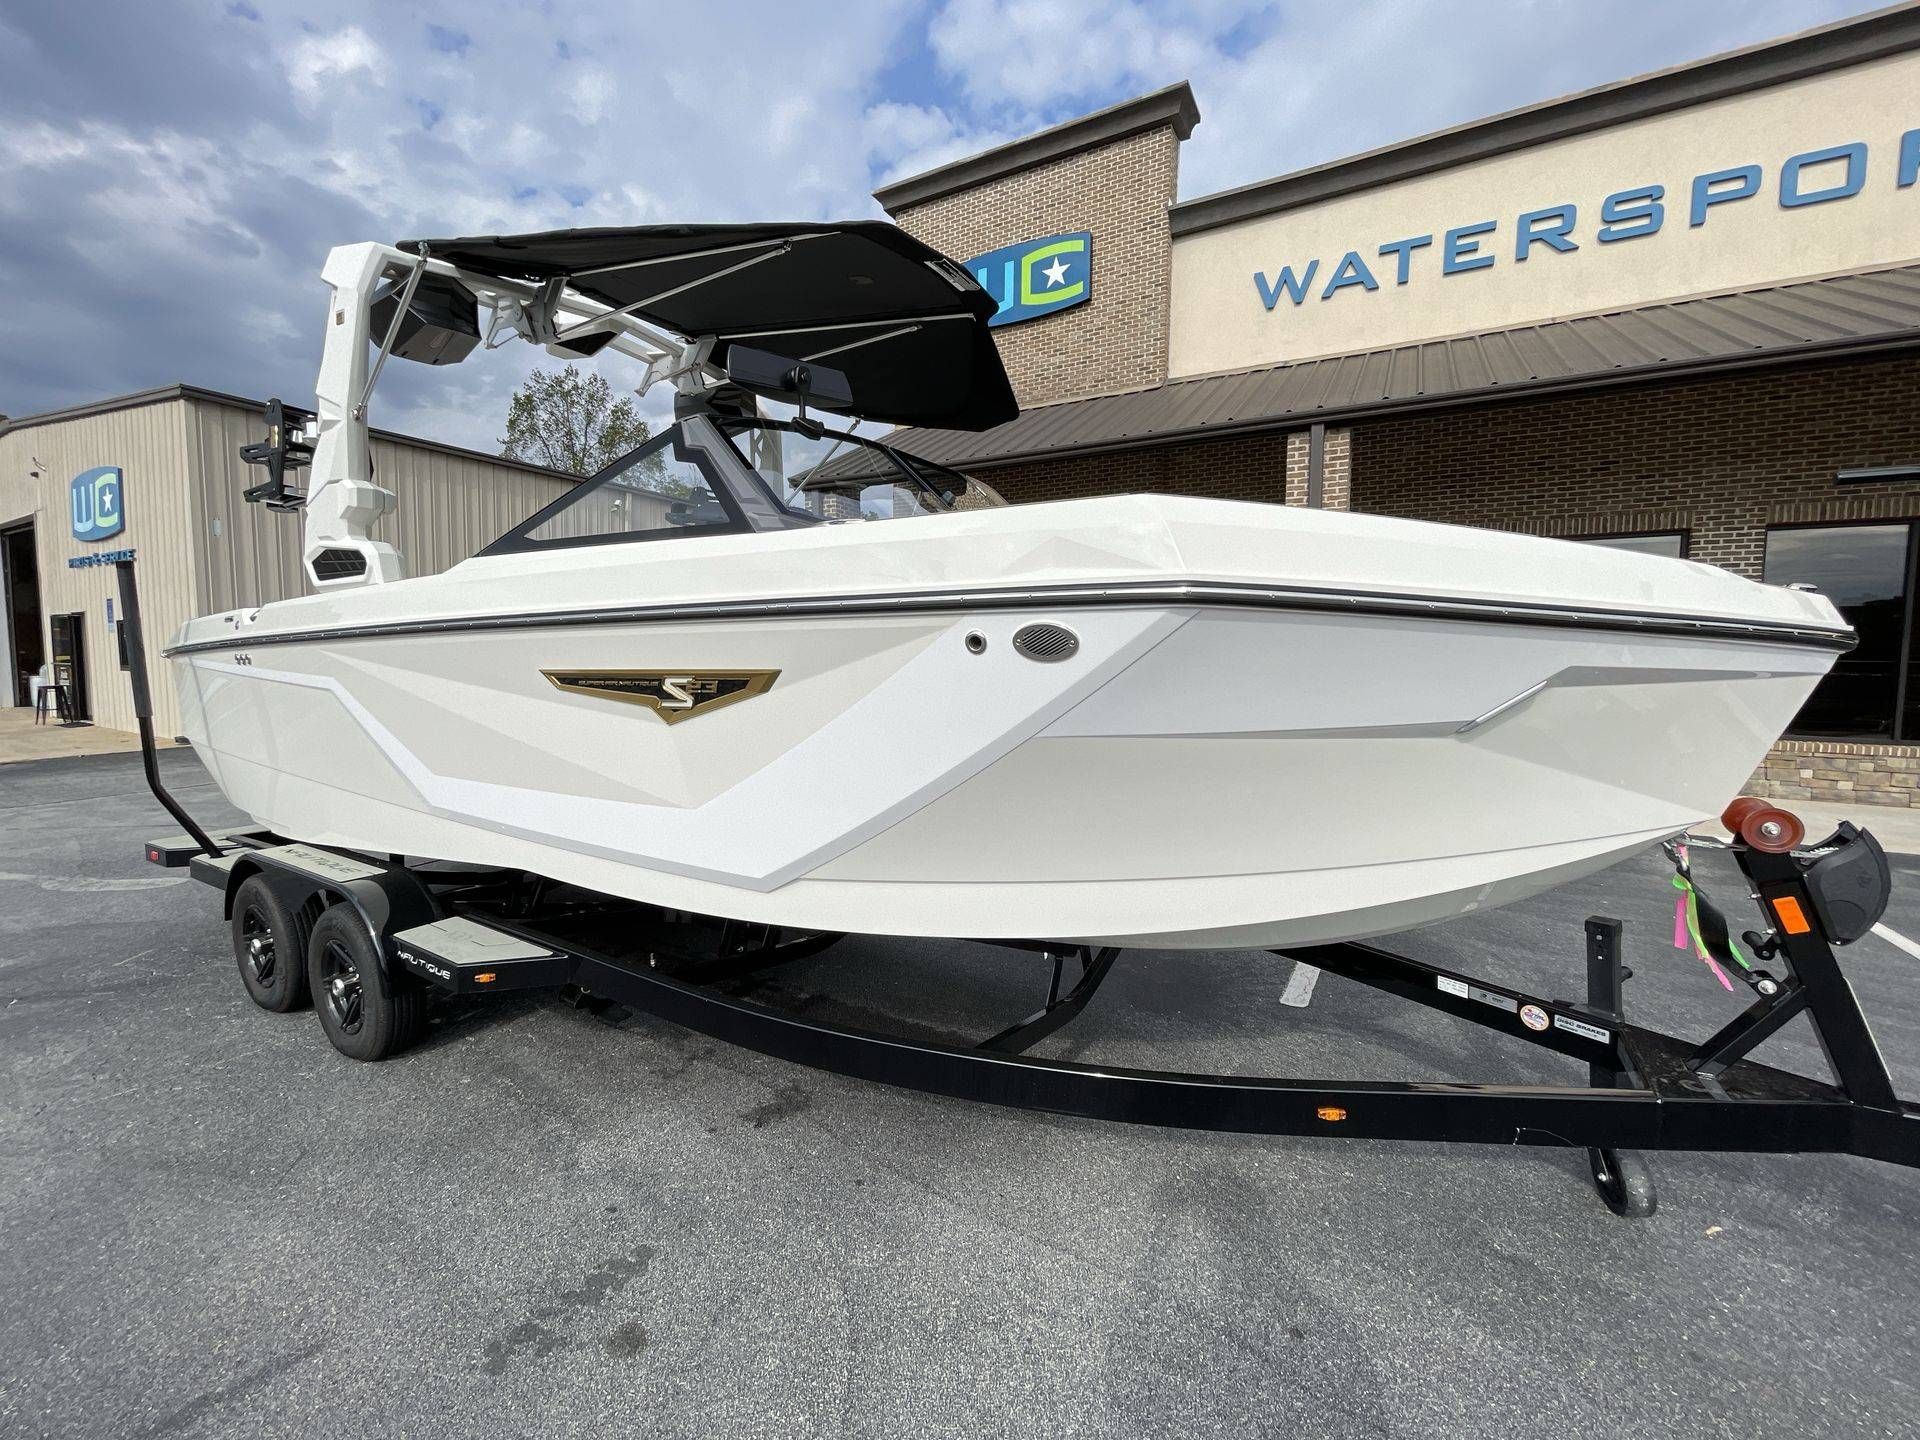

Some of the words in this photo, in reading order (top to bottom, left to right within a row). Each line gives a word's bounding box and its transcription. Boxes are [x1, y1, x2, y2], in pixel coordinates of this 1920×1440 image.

[397, 950, 451, 980] NAUTIQUE
[1556, 1017, 1575, 1027] DISC
[1575, 1023, 1607, 1037] BRAKES
